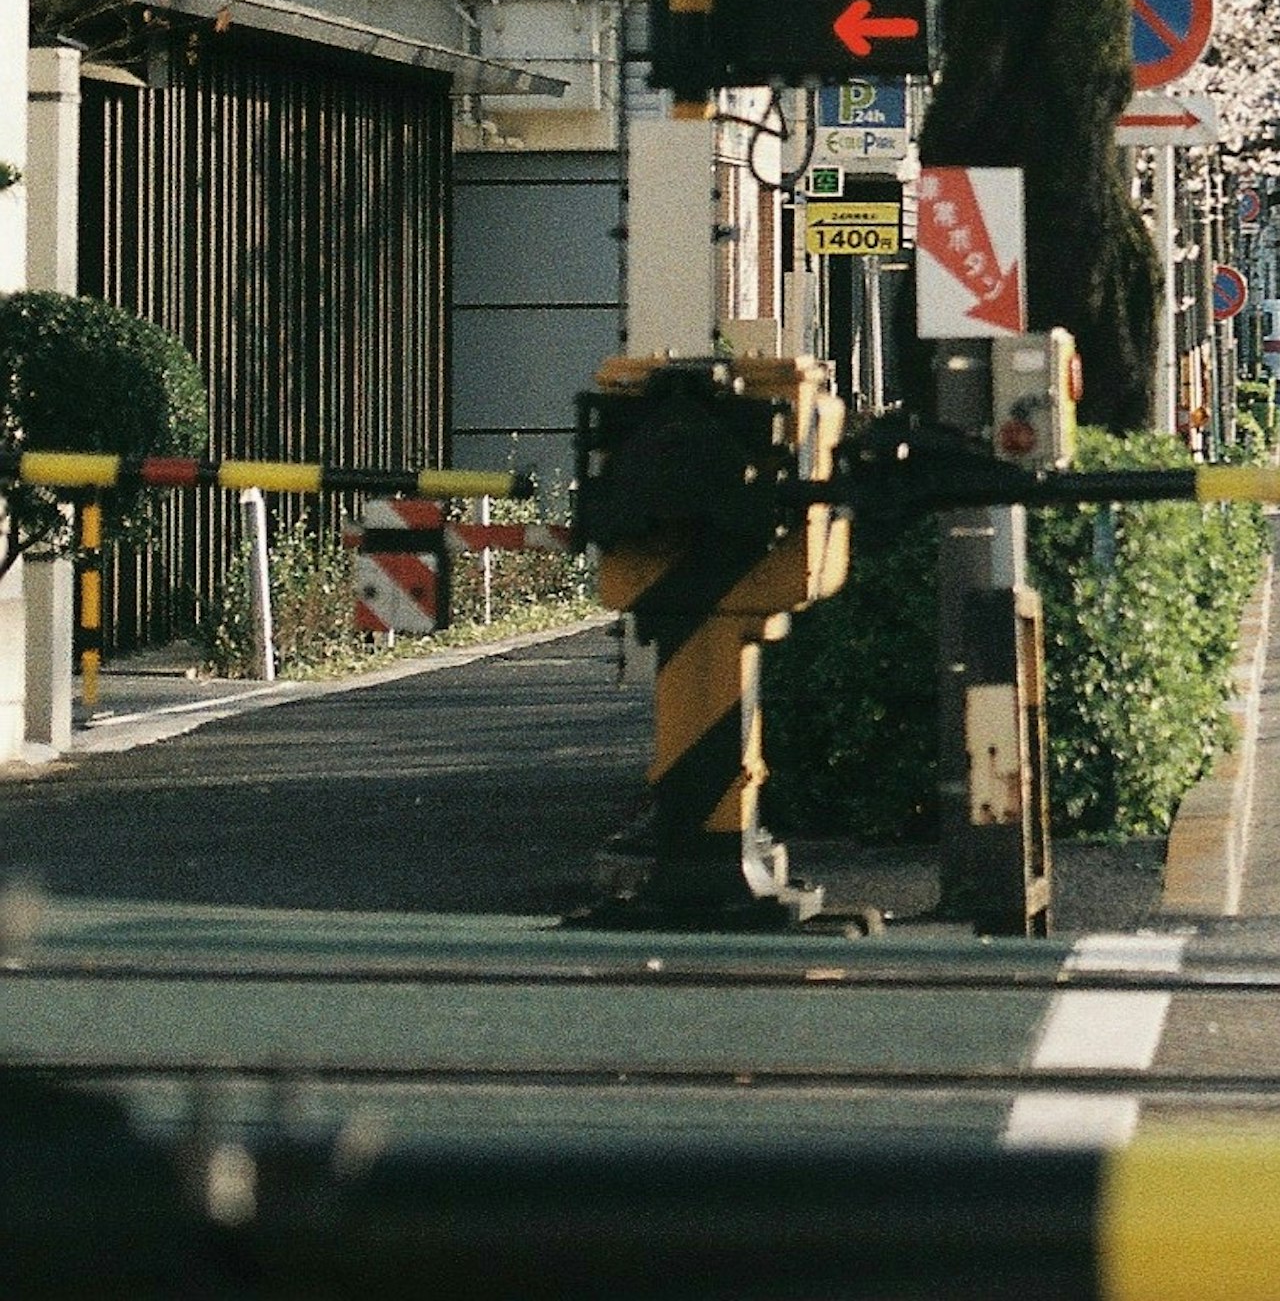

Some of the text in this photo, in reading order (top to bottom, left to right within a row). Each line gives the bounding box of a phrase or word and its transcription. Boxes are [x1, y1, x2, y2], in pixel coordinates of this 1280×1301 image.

[838, 78, 876, 124] P
[854, 111, 885, 123] 24h
[815, 229, 892, 250] 1400円
